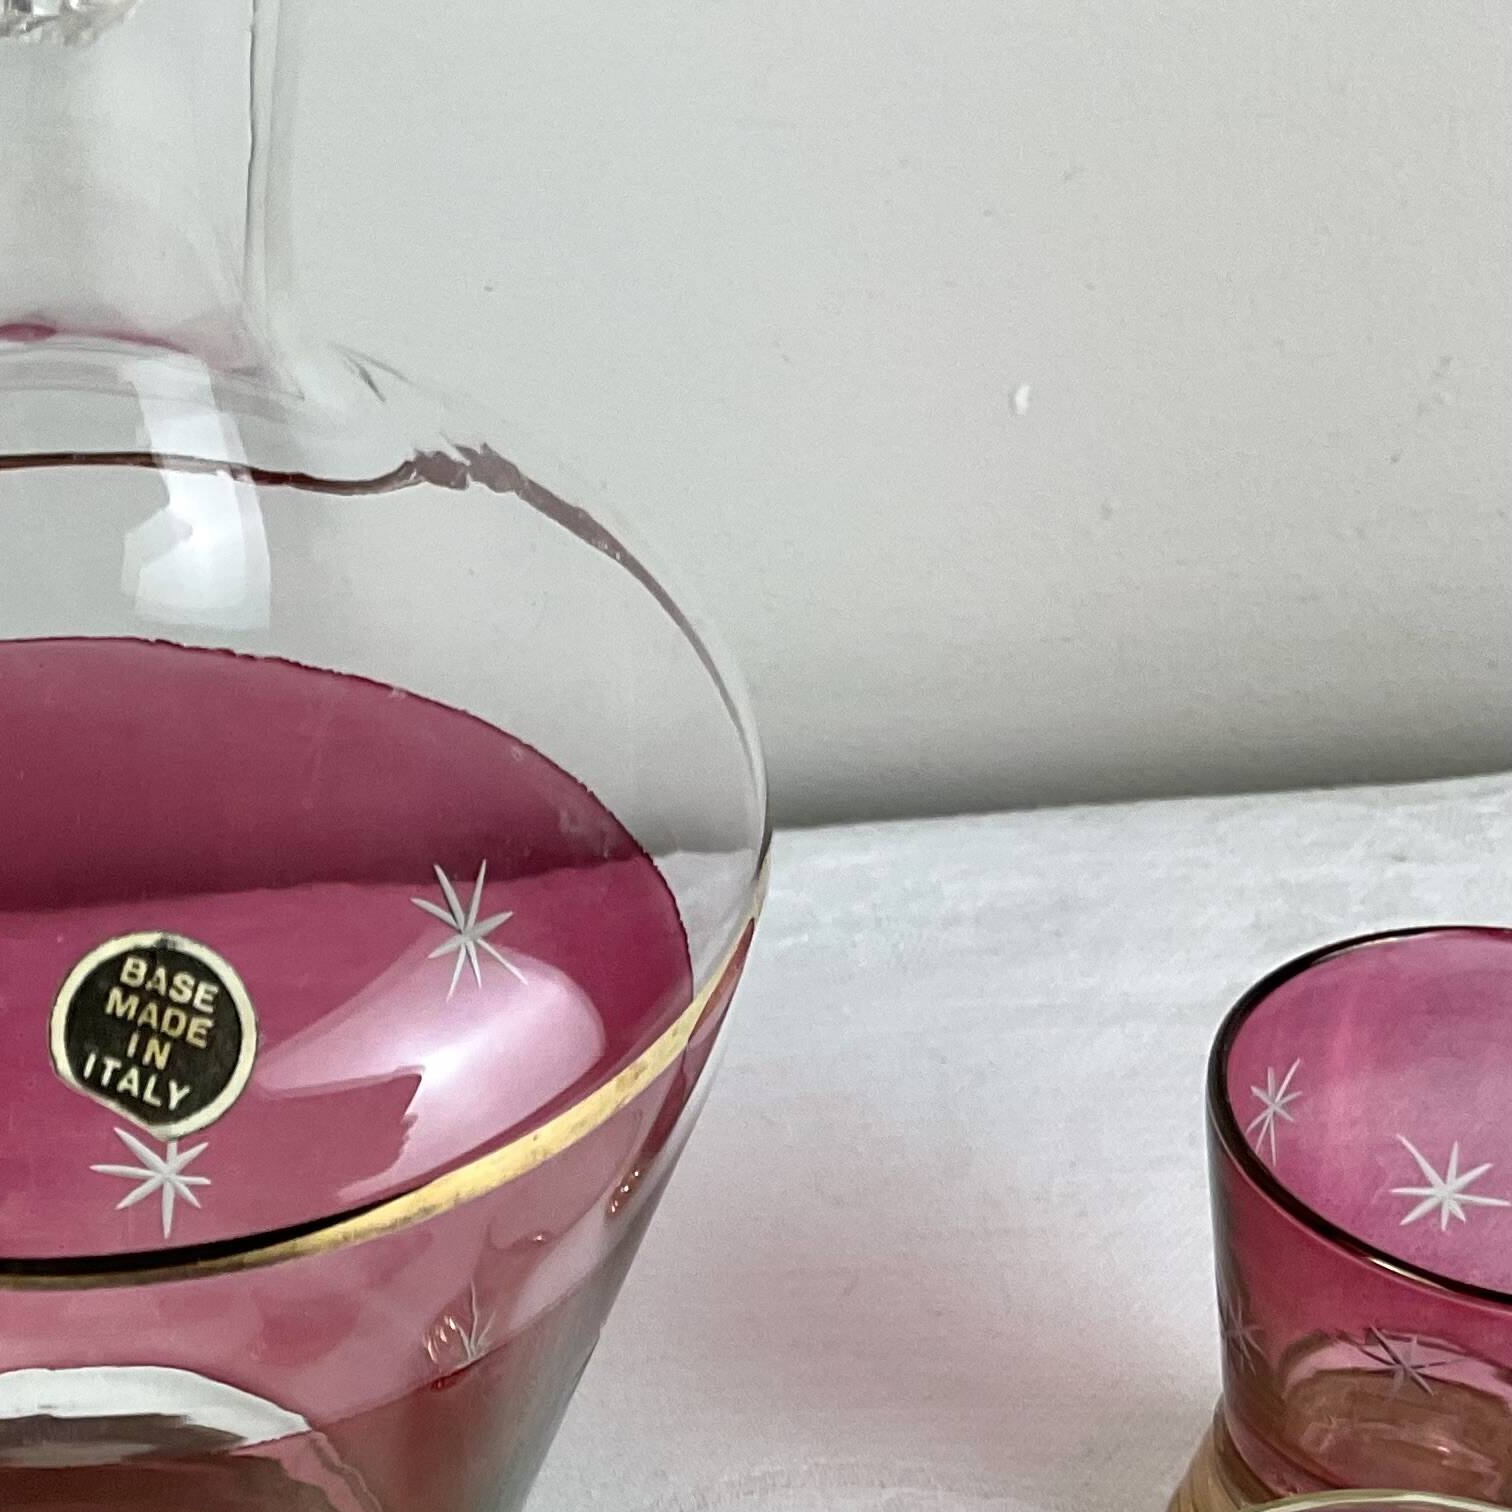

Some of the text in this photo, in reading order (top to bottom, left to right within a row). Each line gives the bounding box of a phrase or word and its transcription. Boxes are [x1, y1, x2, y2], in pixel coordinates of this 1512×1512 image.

[120, 957, 219, 1013] BASE
[105, 986, 215, 1049] MADE
[127, 1031, 171, 1070] IN
[83, 1052, 190, 1111] ITALY
